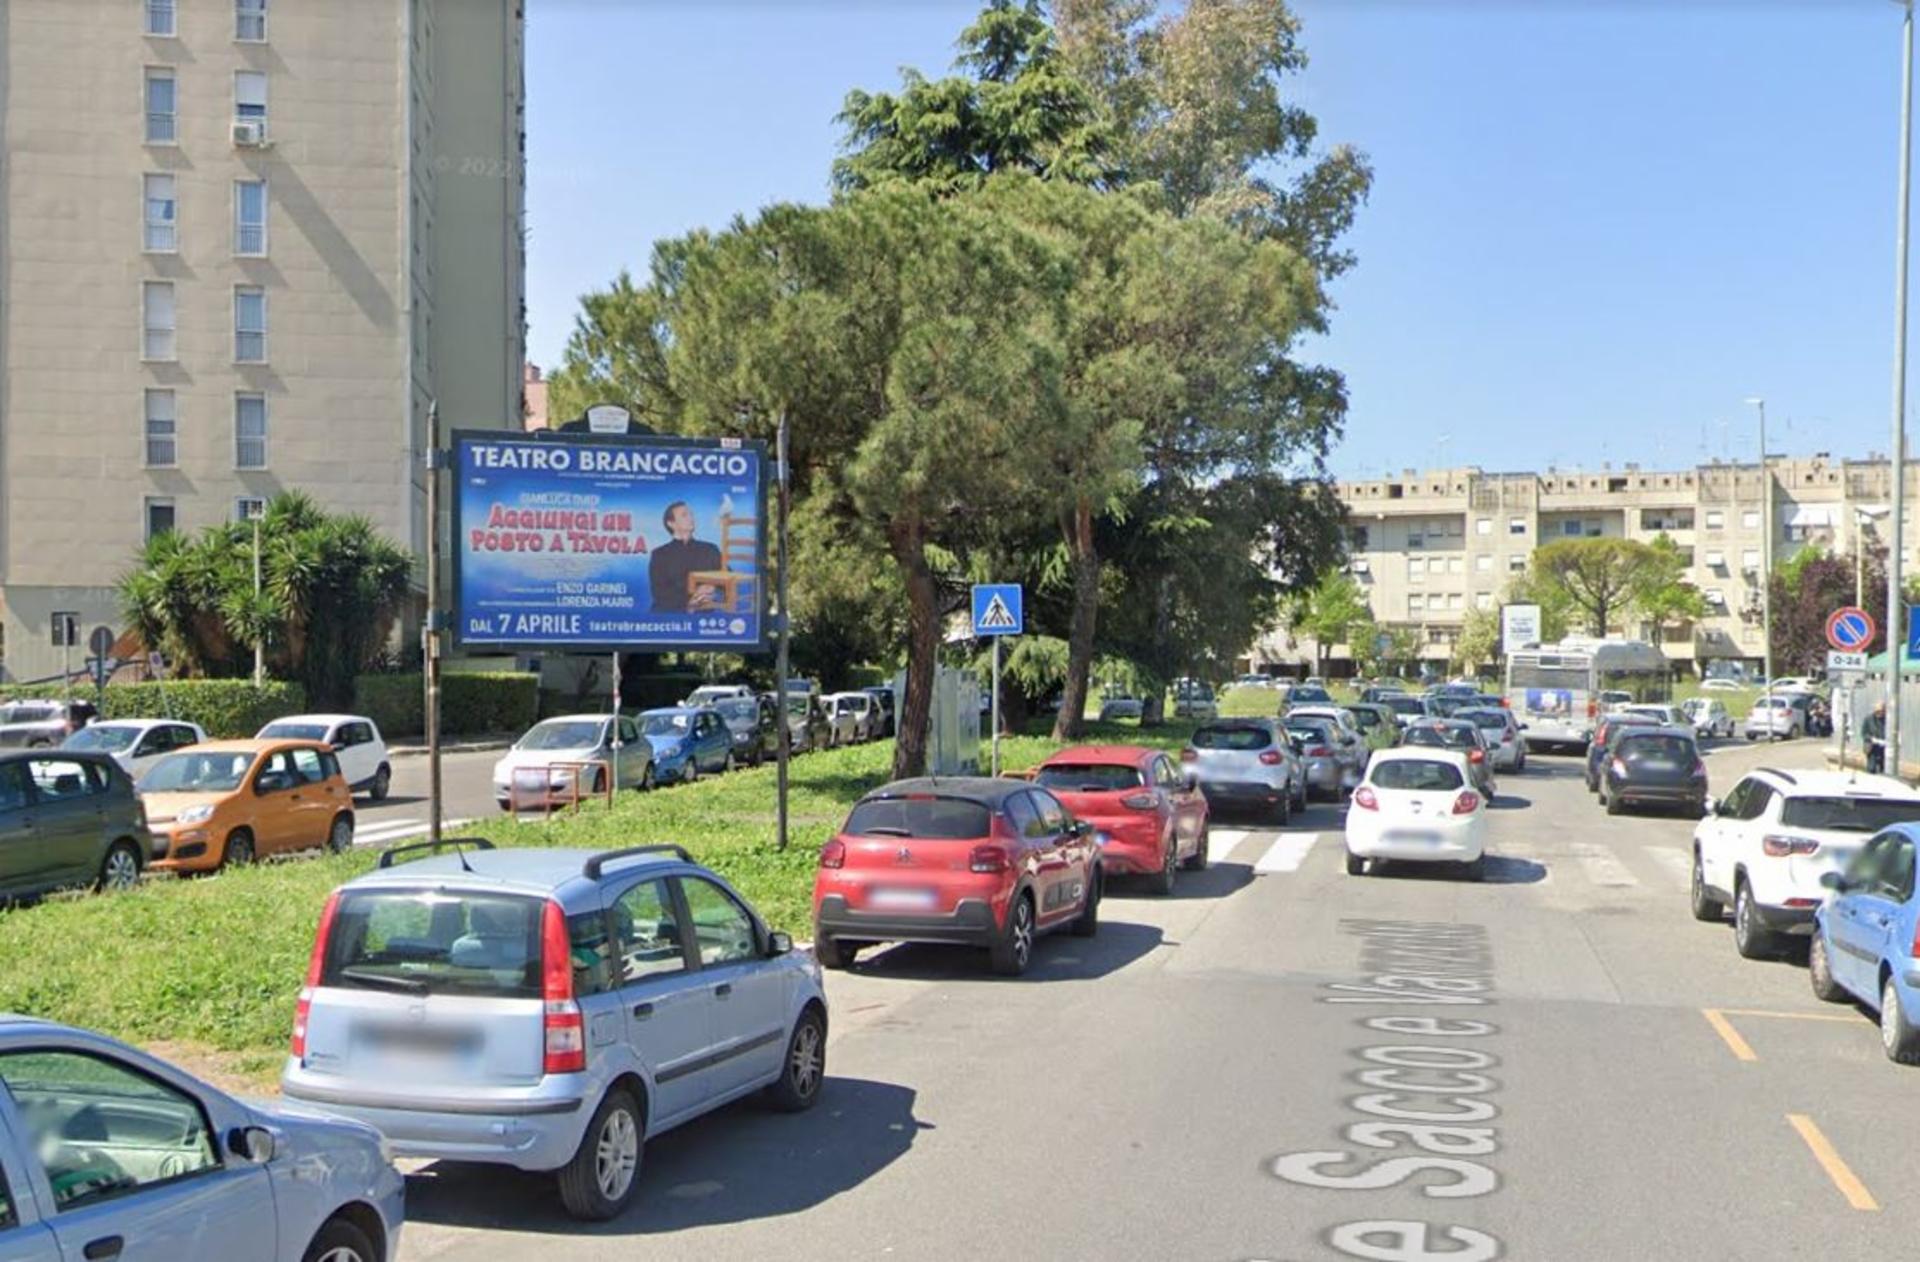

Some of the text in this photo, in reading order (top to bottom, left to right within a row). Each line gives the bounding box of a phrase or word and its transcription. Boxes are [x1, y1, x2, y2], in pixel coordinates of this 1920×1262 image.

[471, 446, 748, 475] TEATRO BRANCACCIO
[471, 529, 648, 555] POSTO A TAVOLA
[470, 614, 581, 634] DAL 7 APRILE
[589, 621, 692, 632] teatrobrancaccio.it
